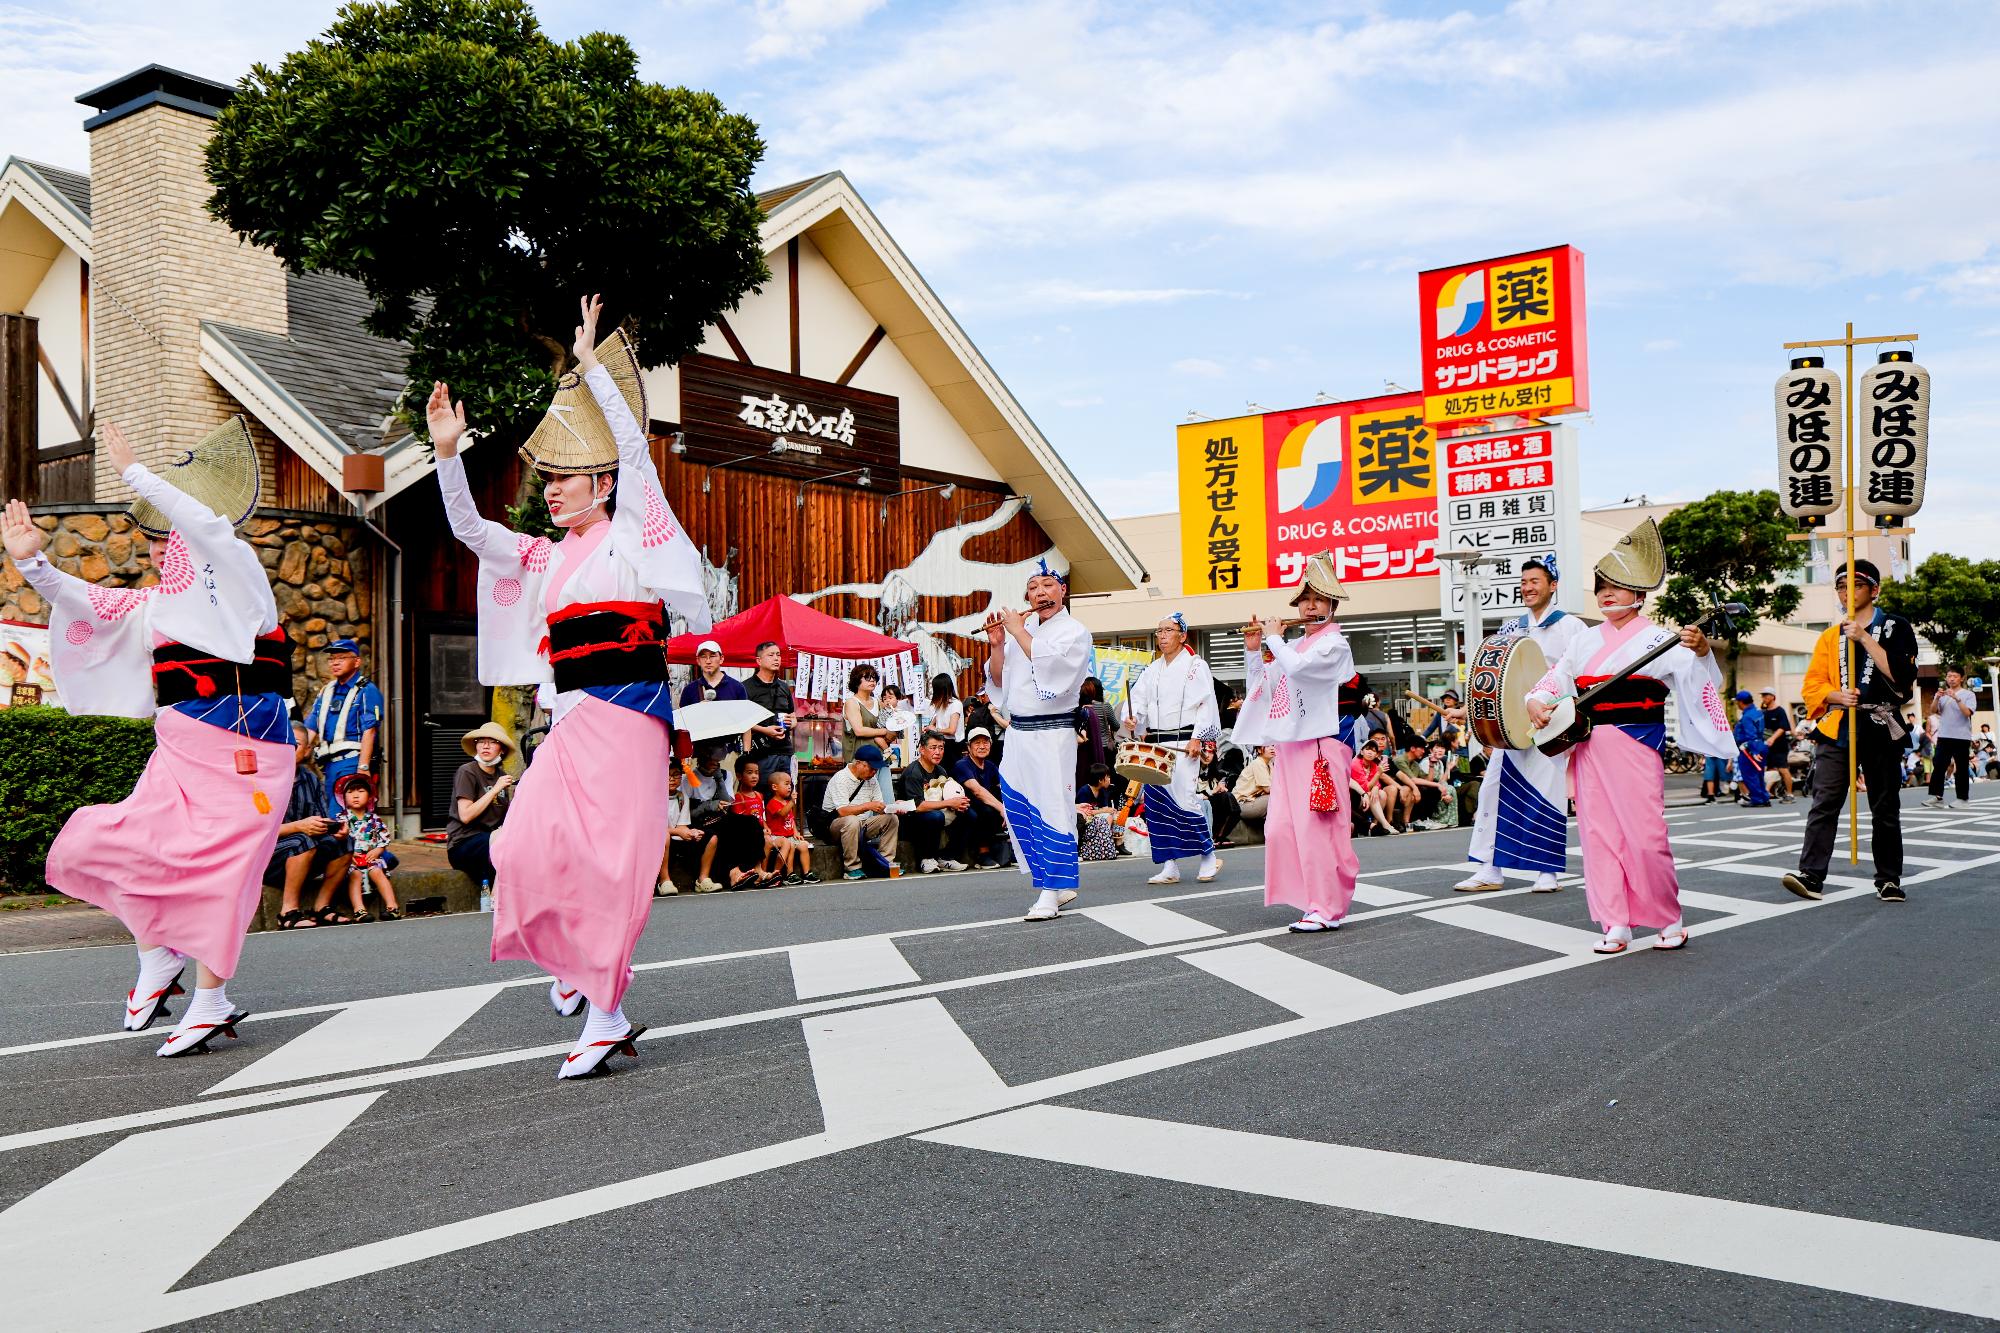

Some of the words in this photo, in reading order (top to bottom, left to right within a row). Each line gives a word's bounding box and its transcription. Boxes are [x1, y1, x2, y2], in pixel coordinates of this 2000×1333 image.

[1497, 266, 1549, 325] 薬
[1436, 342, 1474, 360] DRUG
[1476, 339, 1487, 354] &
[1488, 329, 1557, 352] COSMETIC
[1435, 348, 1559, 390] サンドラッグ
[737, 393, 857, 447] 石窯パン工房
[1444, 384, 1552, 416] 処方せん受付
[1358, 413, 1431, 497] 薬
[1454, 435, 1544, 465] 食料品・酒
[1786, 377, 1834, 509] みほの連
[1867, 370, 1920, 506] みほの連
[1455, 465, 1546, 493] 精肉・青果
[1204, 436, 1242, 591] 処方せん受付
[1277, 521, 1326, 542] DRUG
[1331, 519, 1345, 537] &
[1348, 509, 1439, 536] COSMETIC
[1456, 495, 1546, 521] 日用雑貨
[1458, 525, 1547, 548] ベビー用品
[1275, 537, 1441, 585] サドラッグ
